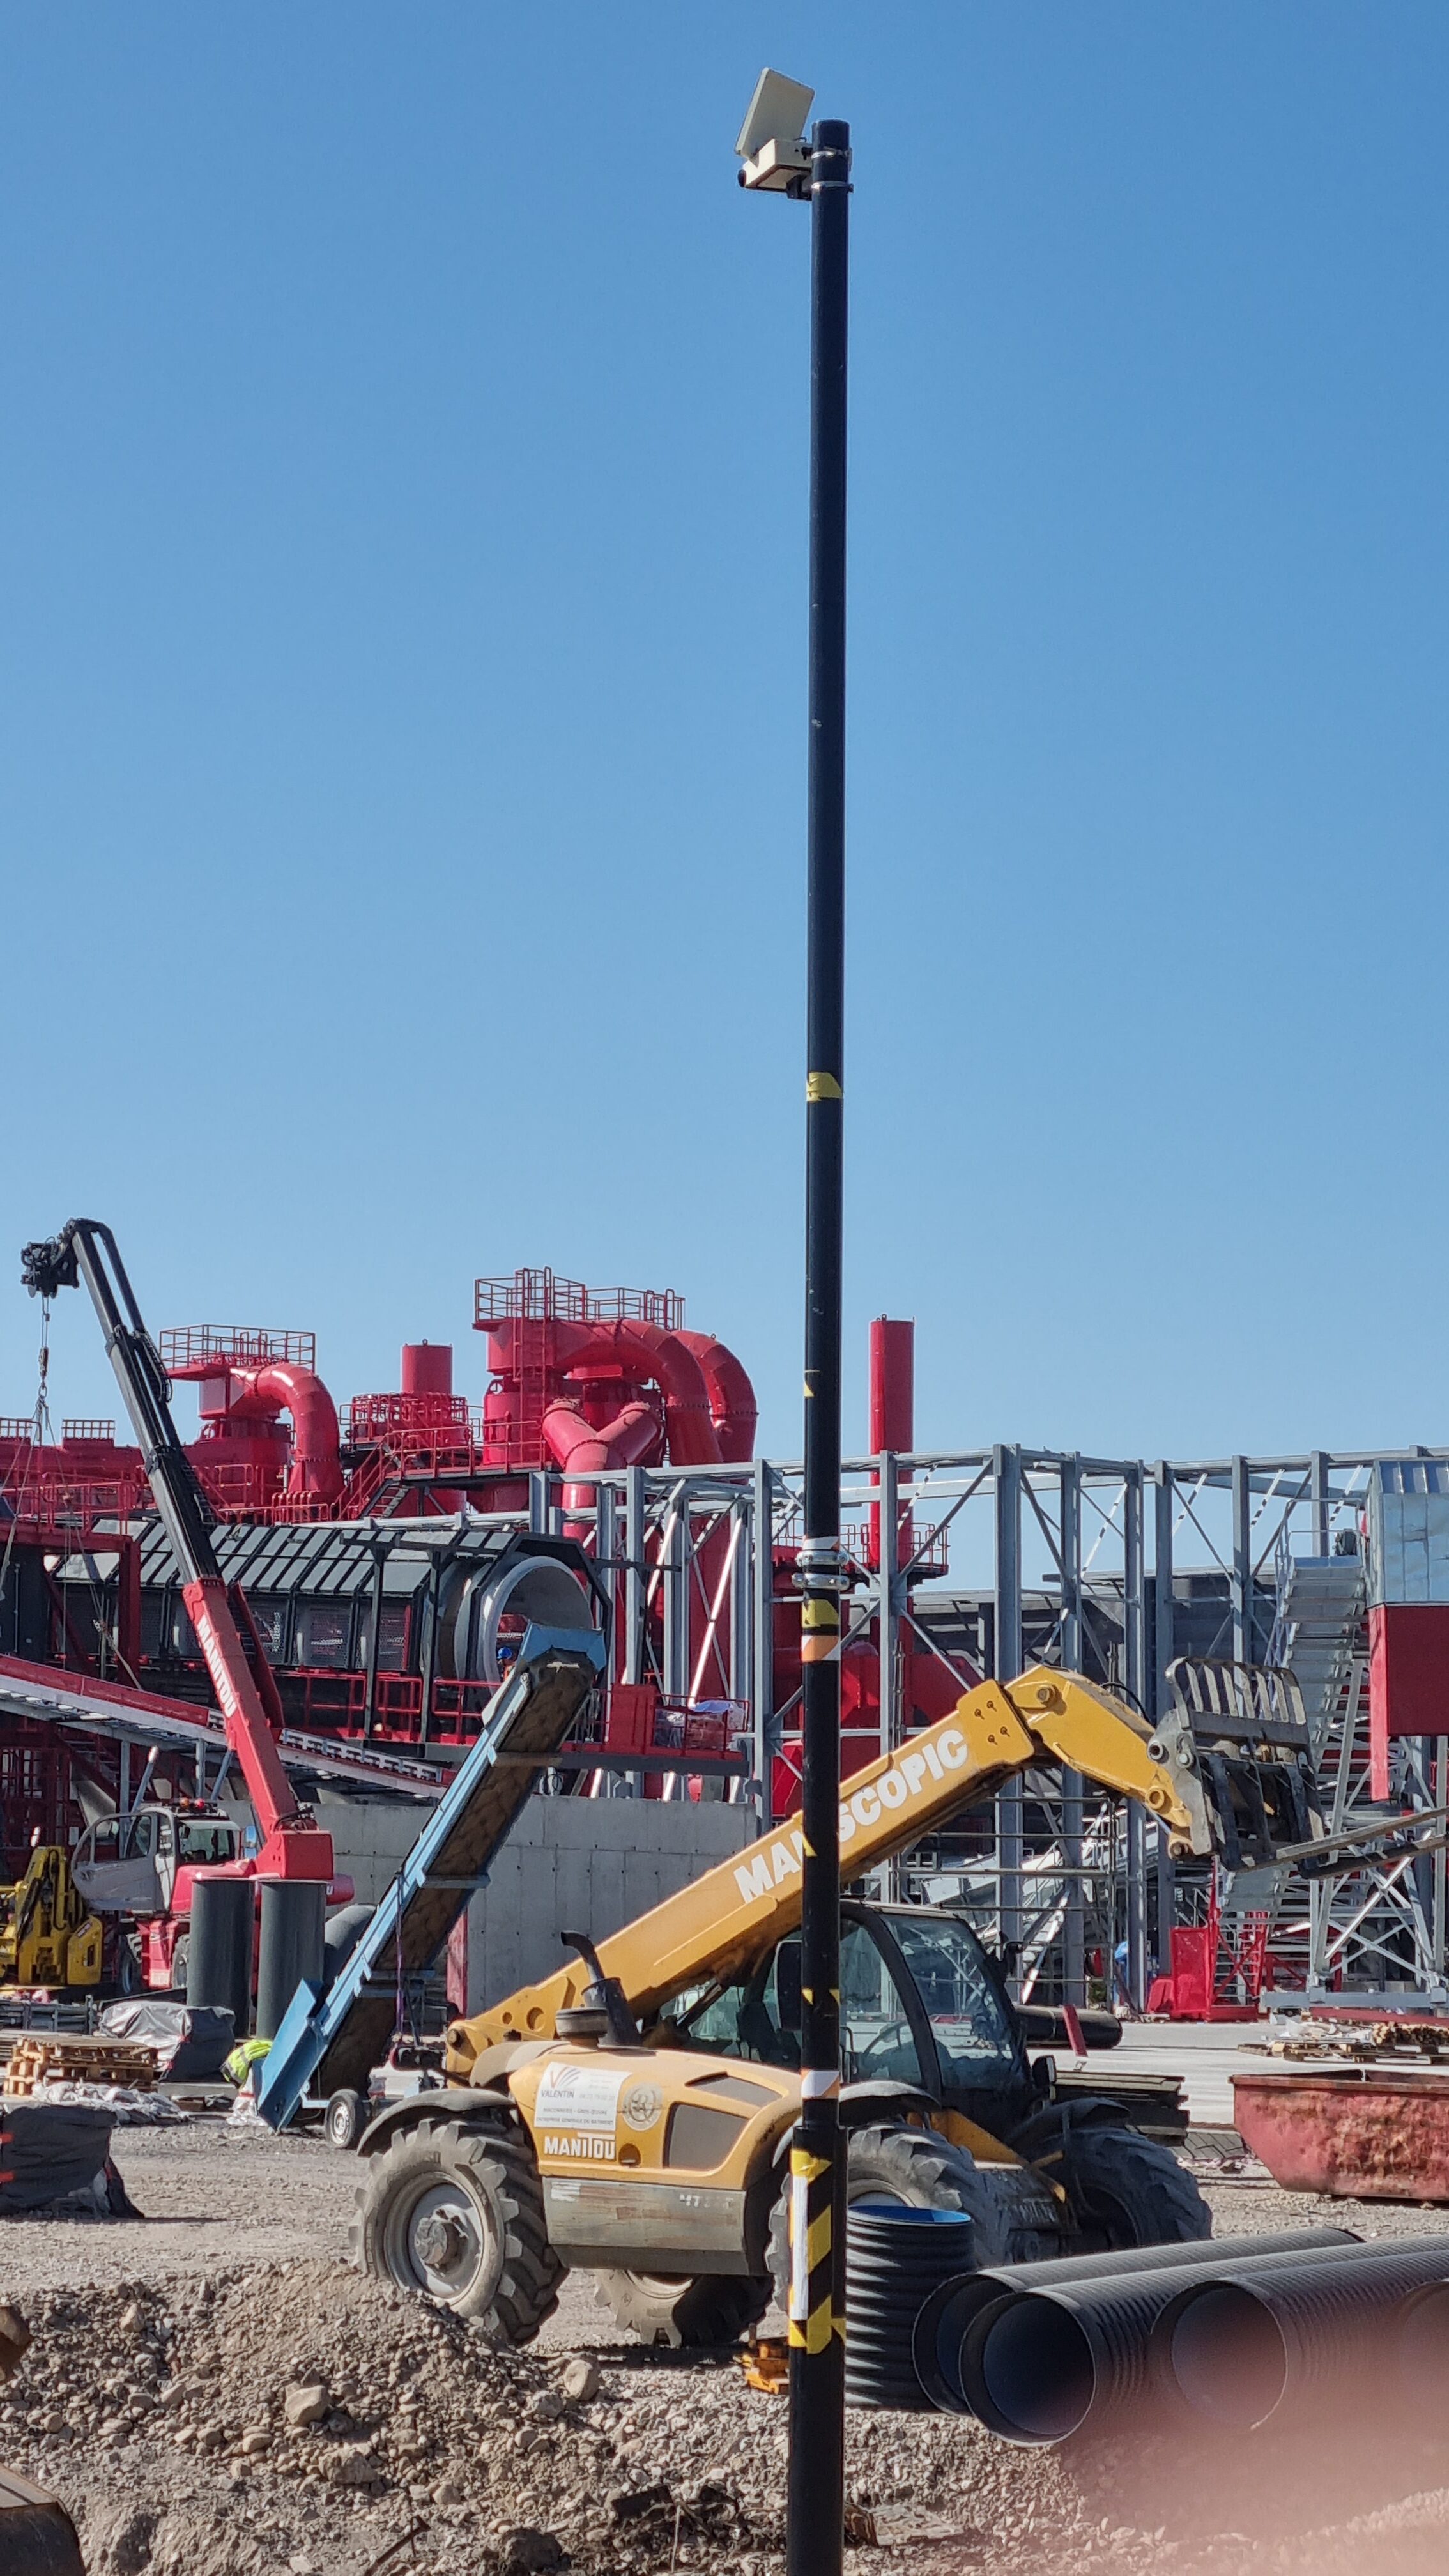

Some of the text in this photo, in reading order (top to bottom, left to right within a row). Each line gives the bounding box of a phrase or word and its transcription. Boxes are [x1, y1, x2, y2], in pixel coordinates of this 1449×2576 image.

[197, 1614, 237, 1718] MANITOU
[541, 2090, 575, 2099] VALENTIN
[544, 2132, 616, 2161] MANITOU
